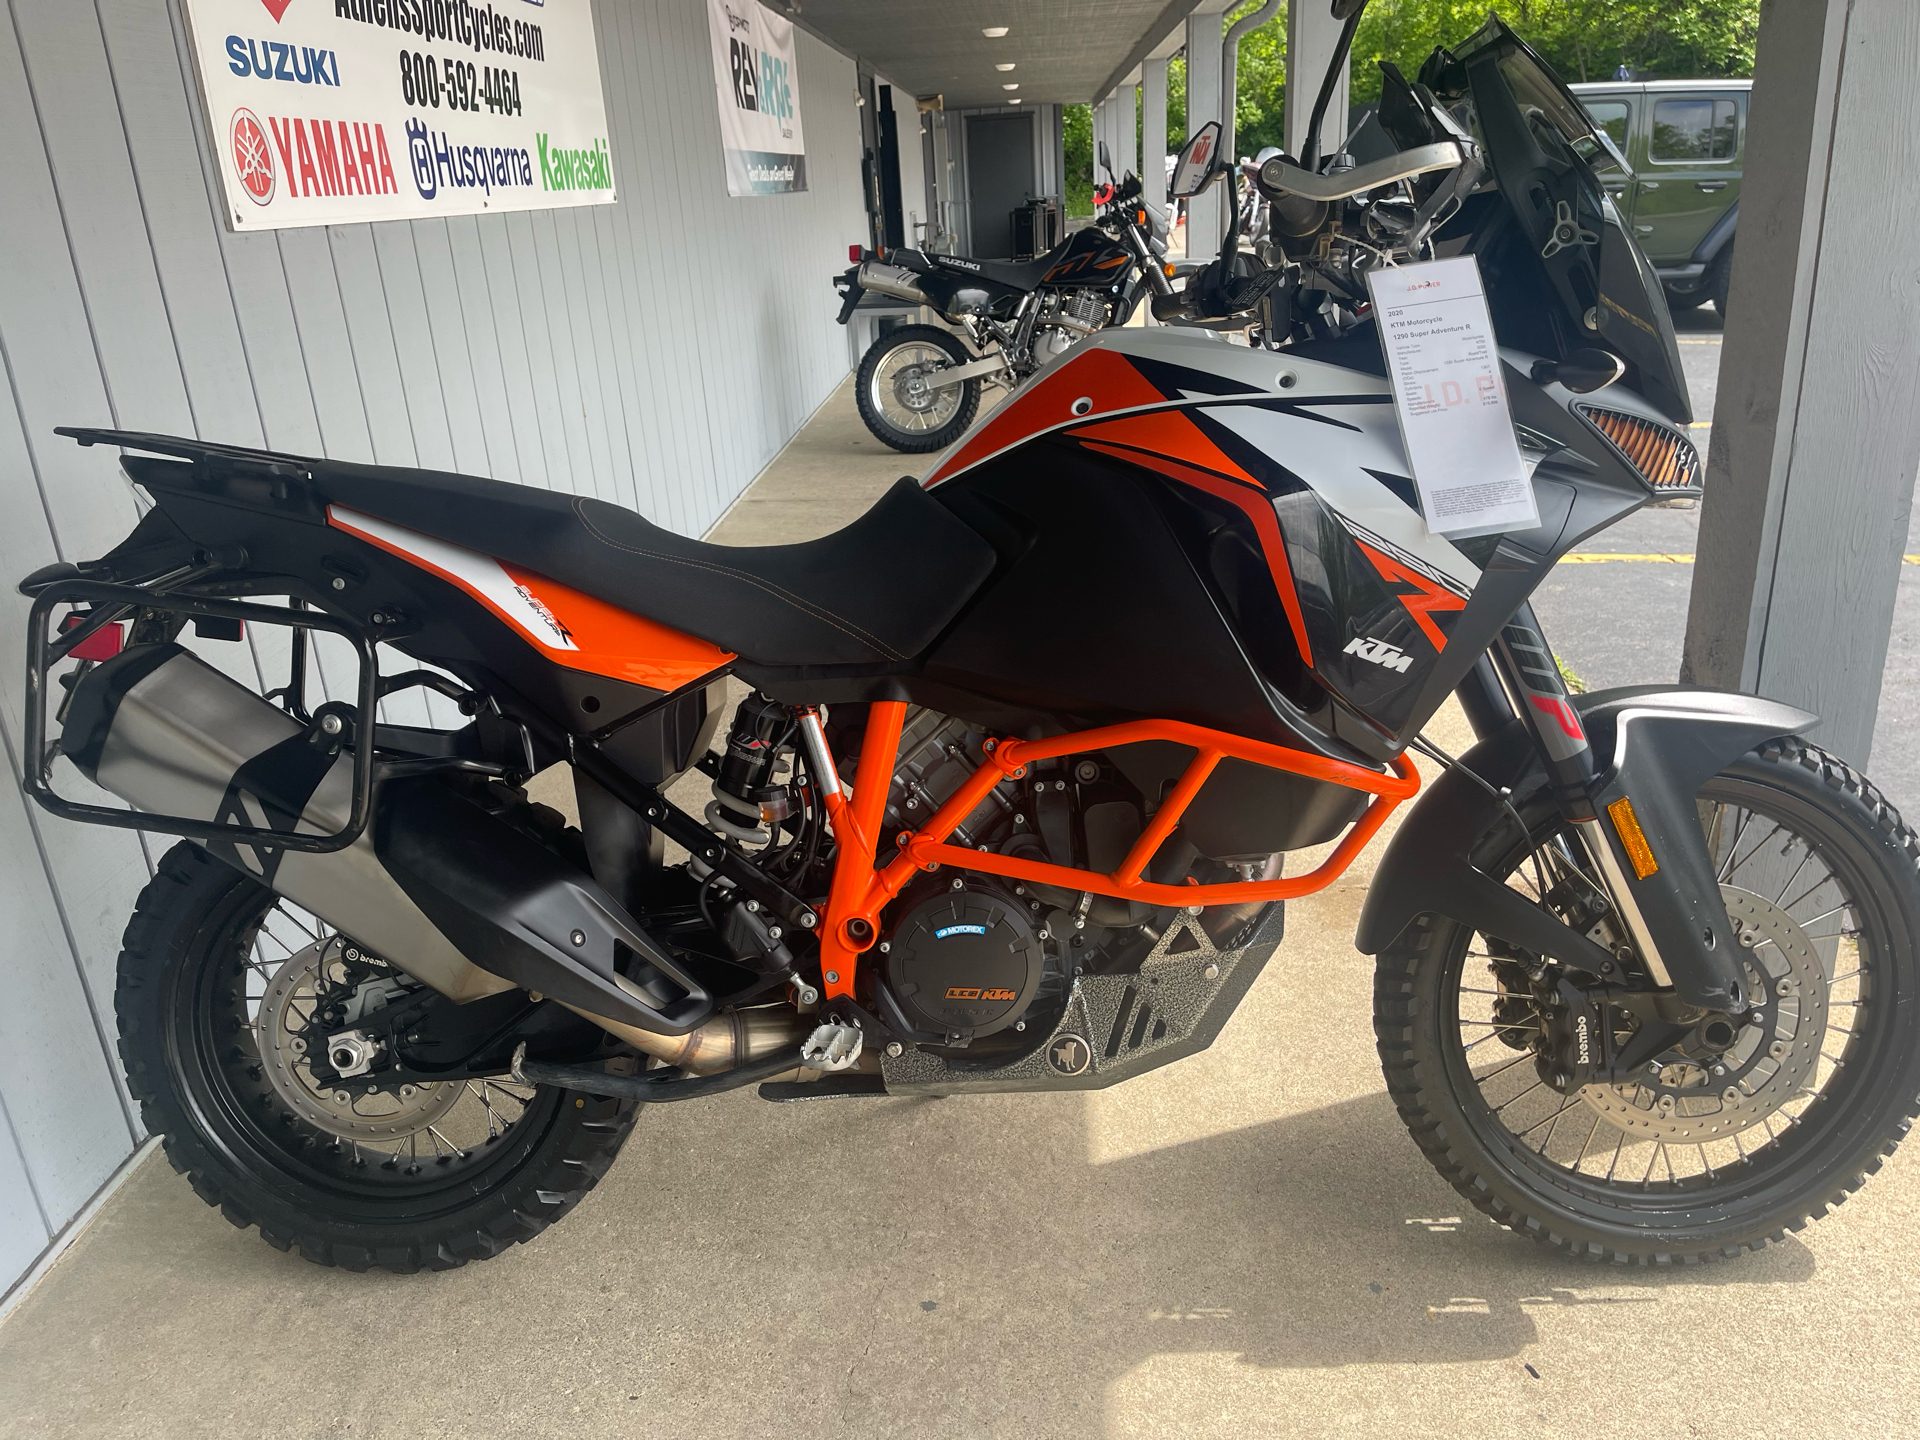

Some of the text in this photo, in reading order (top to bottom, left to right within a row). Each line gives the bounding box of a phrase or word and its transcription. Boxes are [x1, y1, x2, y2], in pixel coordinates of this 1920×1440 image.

[225, 35, 341, 87] SUZUKI
[730, 37, 759, 112] REV
[399, 50, 521, 117] 800-592-4464
[268, 116, 399, 198] YAMAHA
[431, 130, 533, 196] Husqvarna
[535, 132, 612, 191] Kawasaki
[938, 256, 981, 271] SUZUKI
[1388, 309, 1404, 317] 2020
[1390, 316, 1443, 329] KTM Motorcycle
[1393, 332, 1409, 340] 1290
[1410, 330, 1429, 338] Super
[1430, 326, 1464, 335] Adventure
[1343, 637, 1414, 673] KTM
[948, 925, 982, 934] MOTOREX
[360, 953, 389, 968] bremb
[981, 988, 1016, 1000] KTM
[1575, 1016, 1590, 1064] brembo
